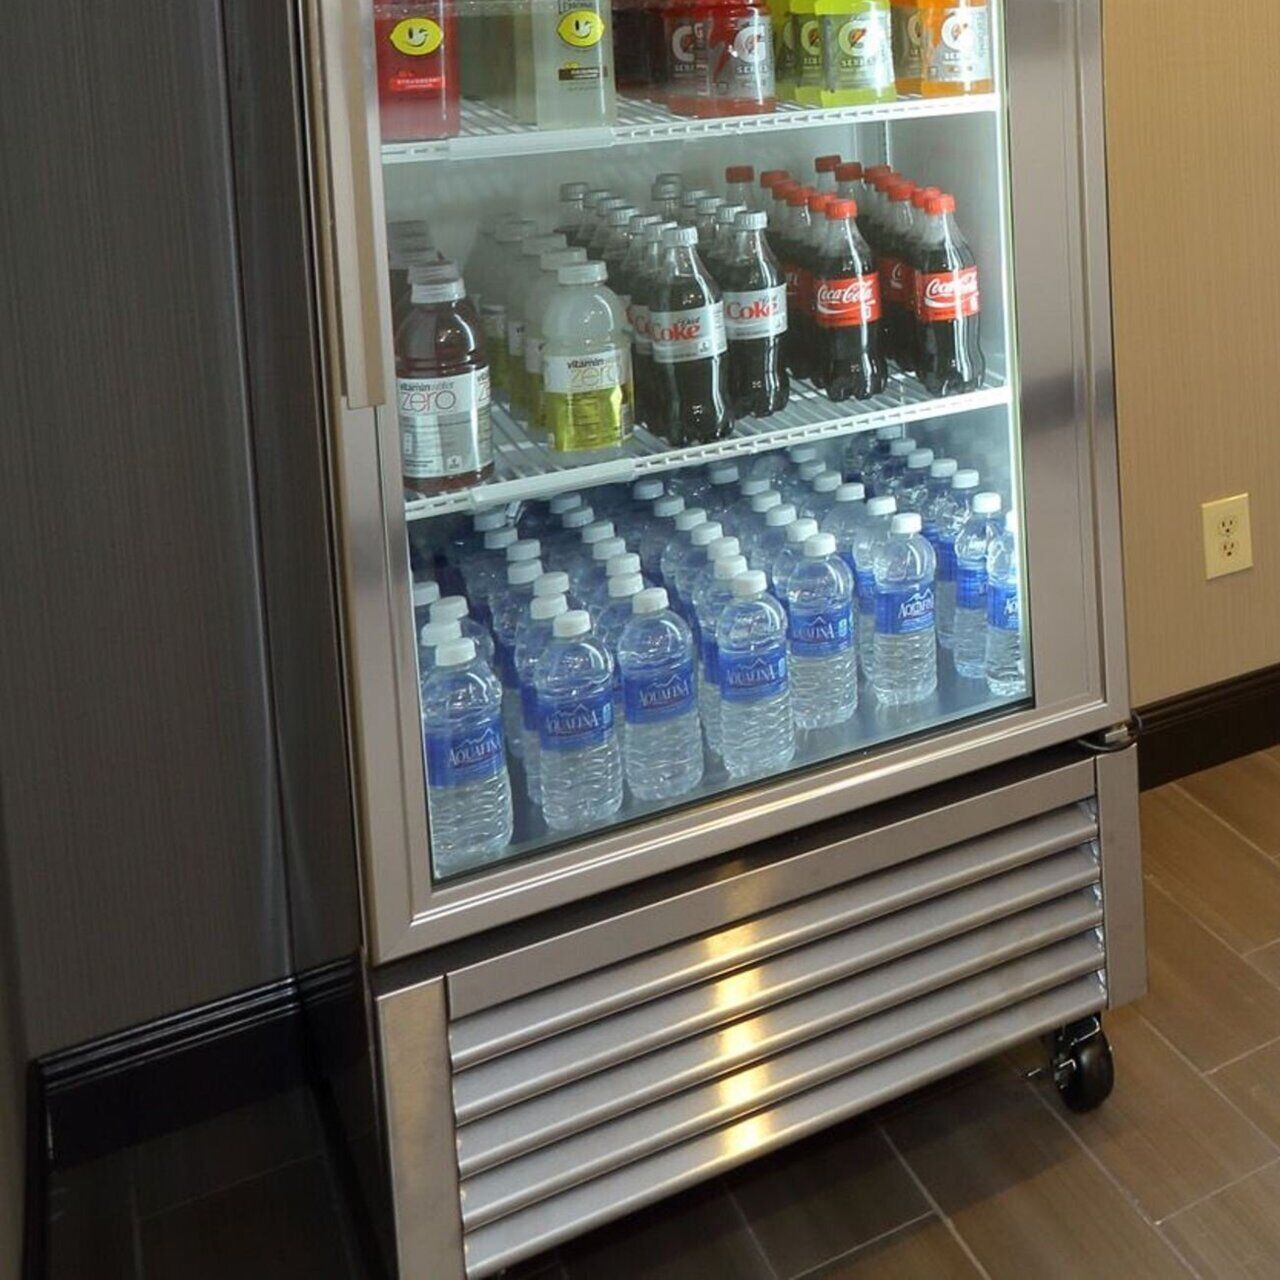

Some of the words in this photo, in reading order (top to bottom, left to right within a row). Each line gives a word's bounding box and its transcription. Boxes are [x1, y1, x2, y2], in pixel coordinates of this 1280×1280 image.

[818, 280, 874, 304] Coca-Cola
[726, 301, 777, 320] Coke
[652, 323, 700, 342] Coke
[401, 389, 457, 412] zero
